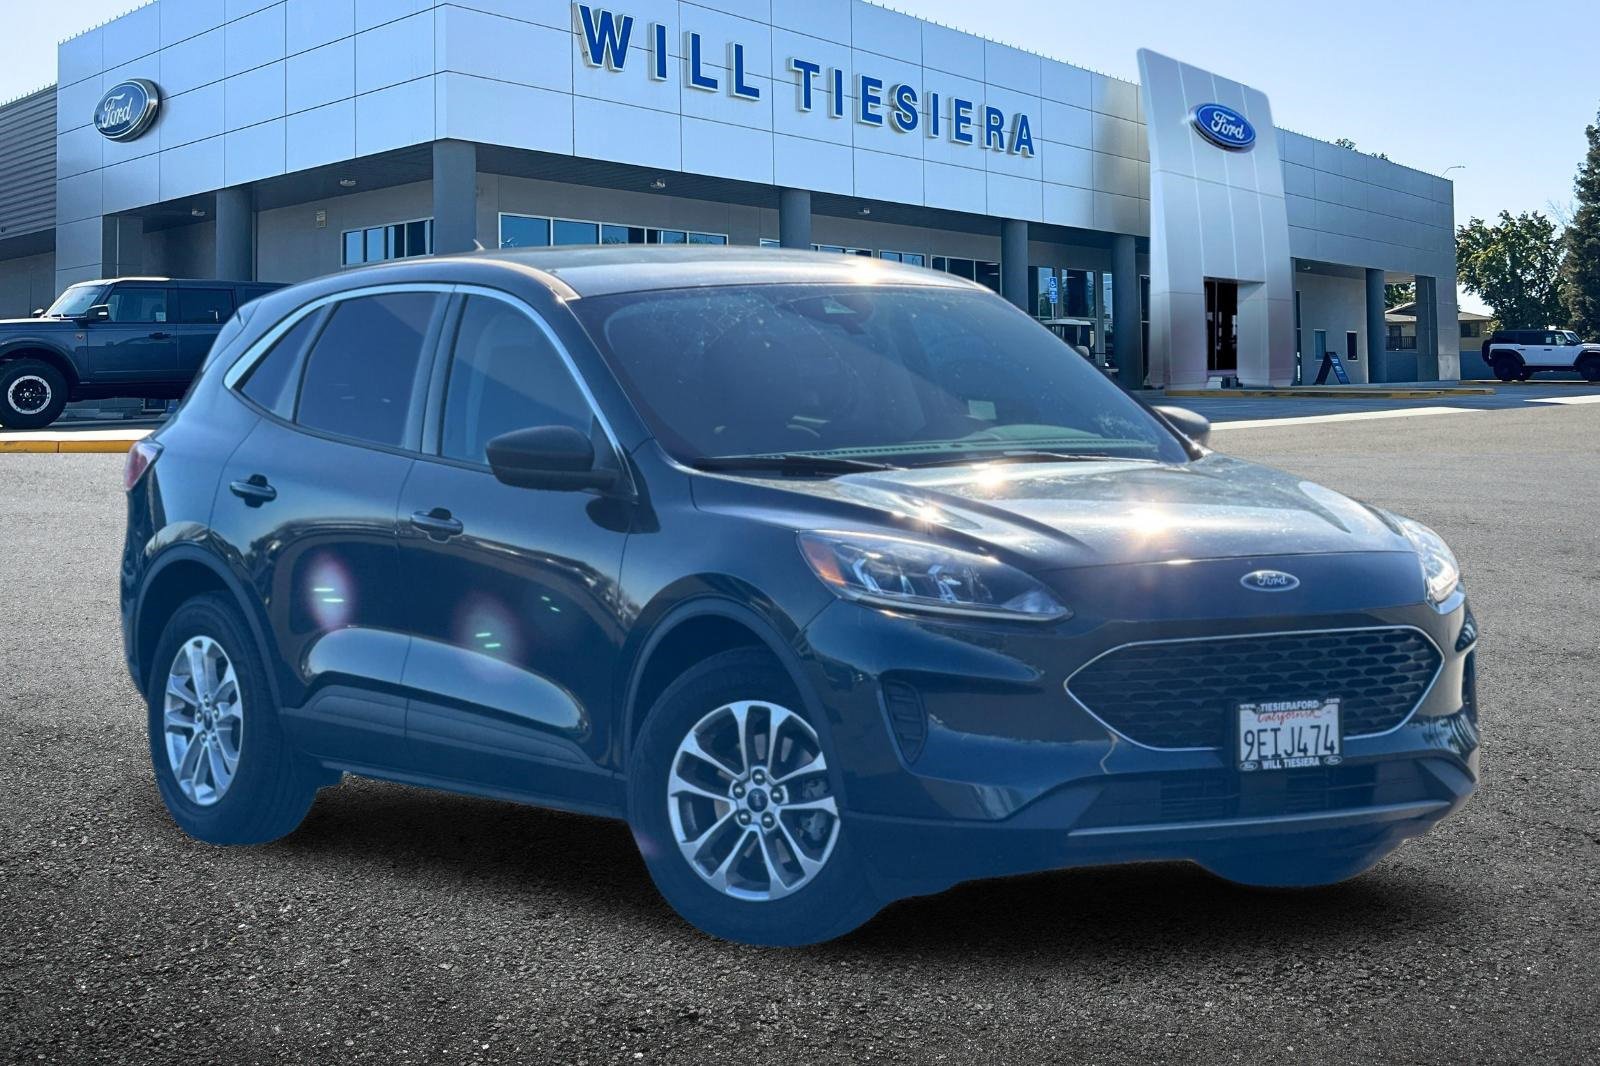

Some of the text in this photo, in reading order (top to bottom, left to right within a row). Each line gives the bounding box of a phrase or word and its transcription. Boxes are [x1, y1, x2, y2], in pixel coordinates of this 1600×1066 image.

[575, 3, 1036, 157] WILL TIESIERA
[101, 93, 133, 129] Ford
[1210, 111, 1245, 139] Ford
[1257, 572, 1287, 586] Ford
[1262, 760, 1281, 770] WILL
[1283, 757, 1320, 768] TIESIERA
